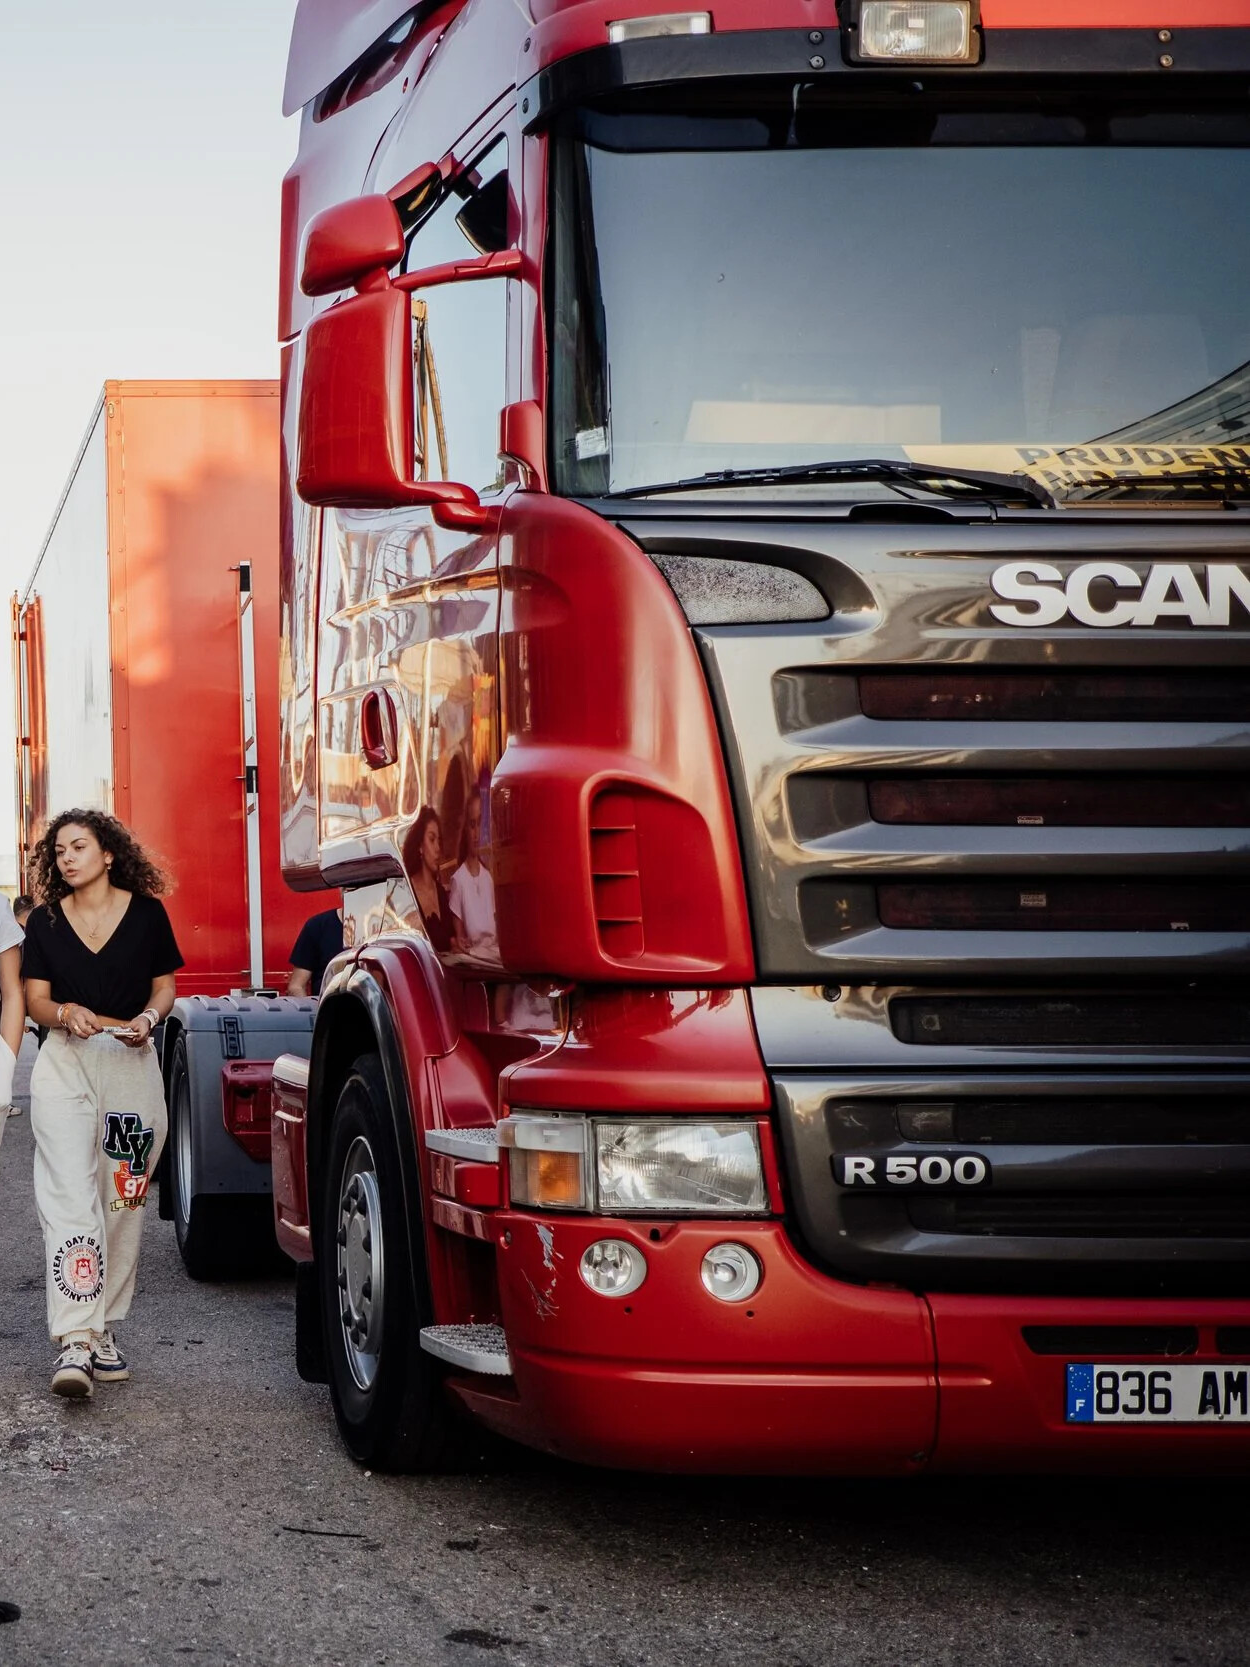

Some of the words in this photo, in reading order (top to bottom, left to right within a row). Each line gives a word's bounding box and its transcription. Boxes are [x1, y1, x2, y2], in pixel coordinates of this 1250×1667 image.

[1015, 447, 1250, 467] PRUDEN
[103, 1112, 154, 1173] NY
[844, 1156, 876, 1185] R
[886, 1156, 986, 1185] 500
[123, 1177, 148, 1198] 97
[53, 1247, 65, 1283] EVERY
[65, 1235, 84, 1248] DAY
[87, 1237, 96, 1247] IS
[1075, 1399, 1086, 1412] F
[1095, 1370, 1172, 1415] 836
[1197, 1371, 1248, 1415] AM
